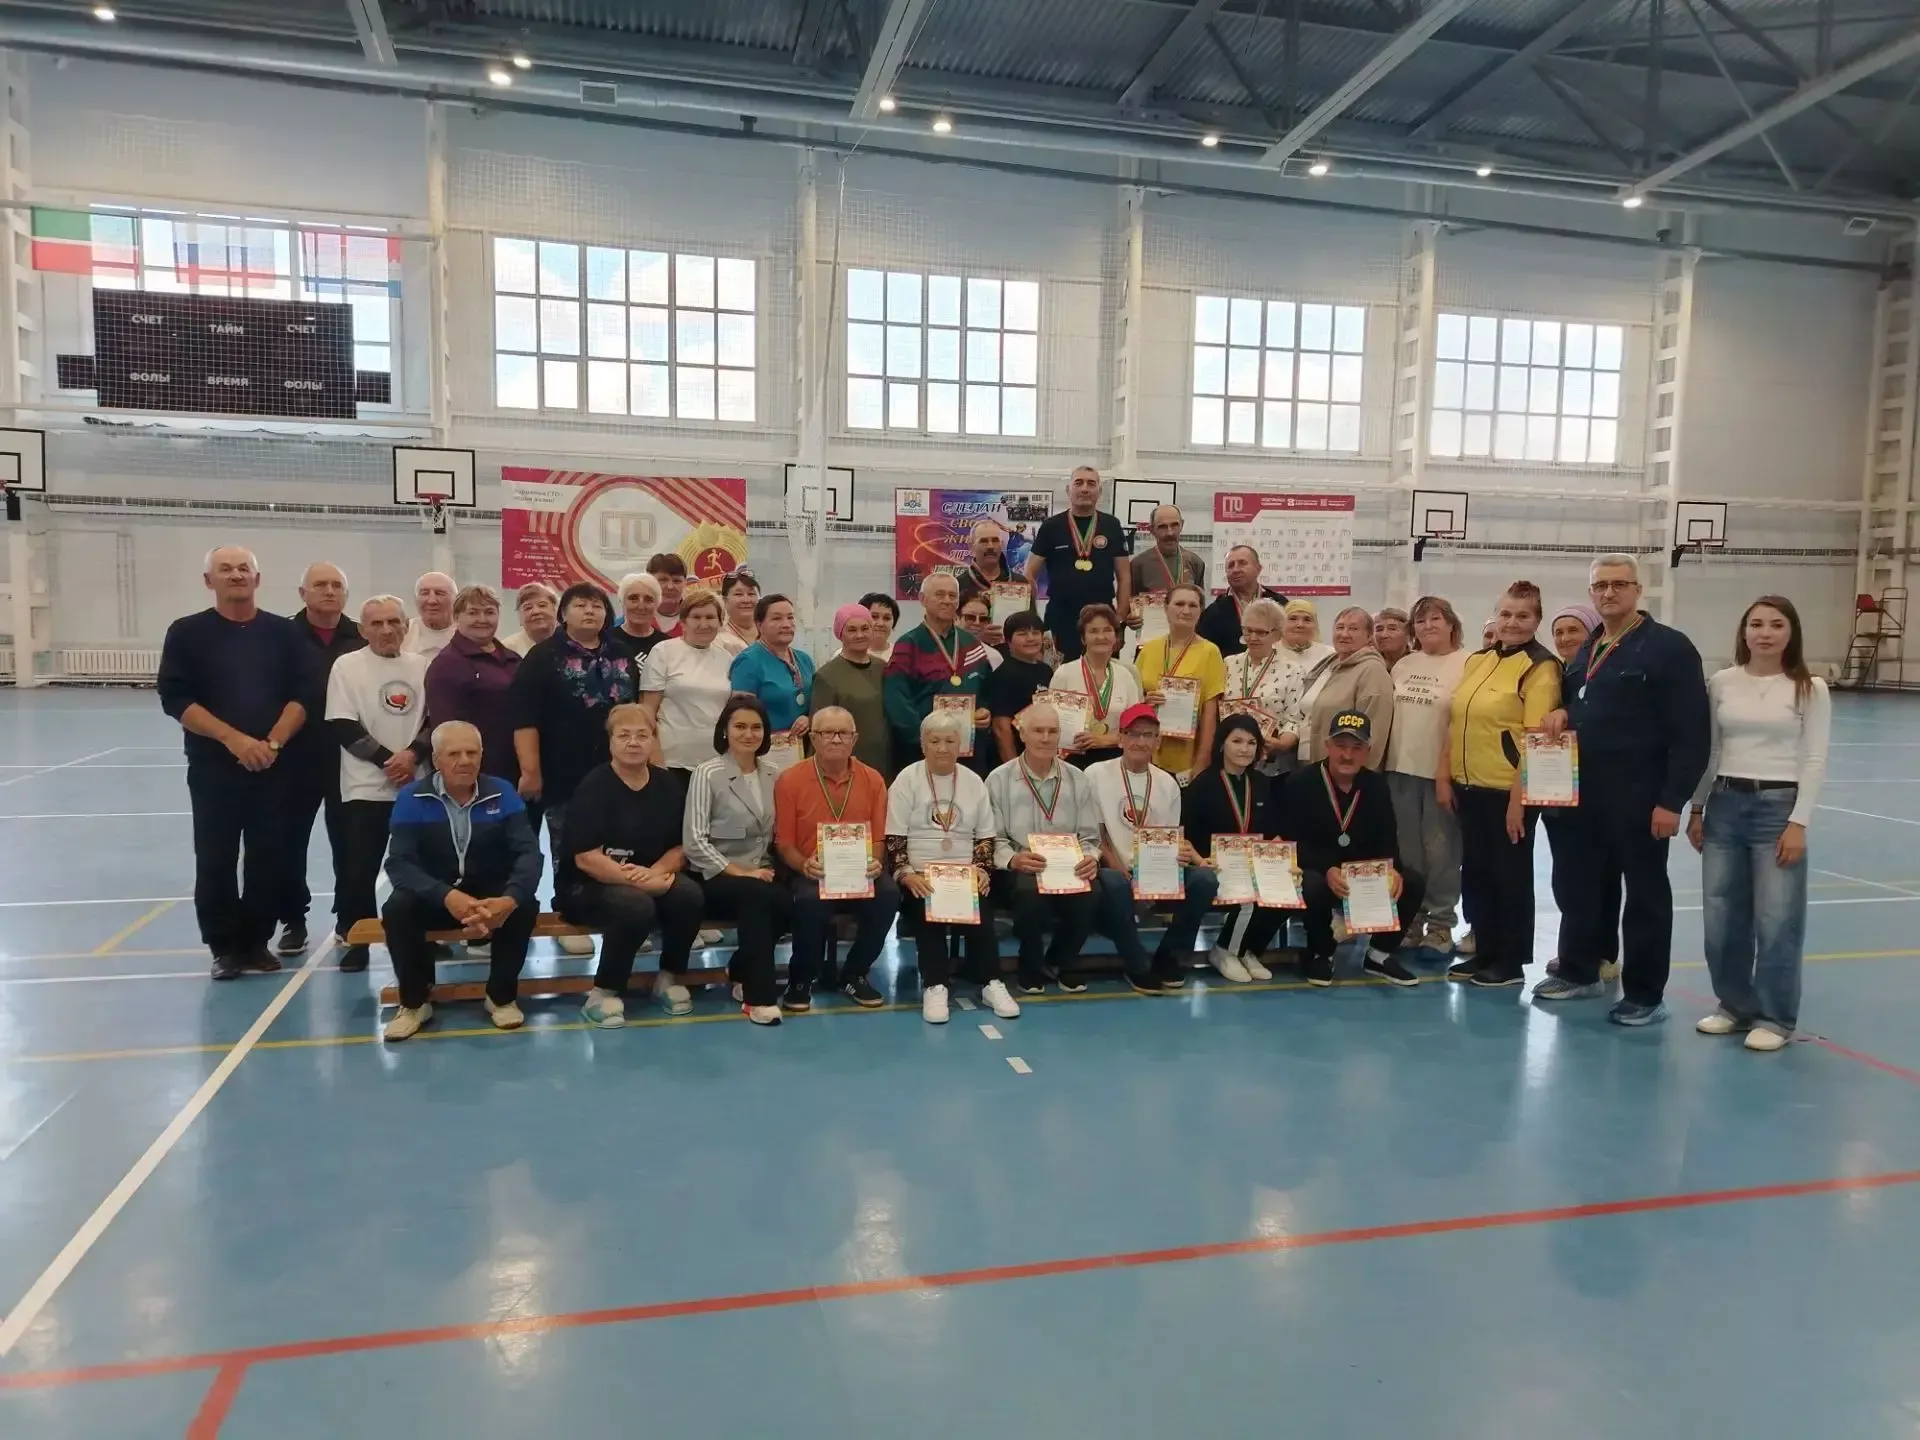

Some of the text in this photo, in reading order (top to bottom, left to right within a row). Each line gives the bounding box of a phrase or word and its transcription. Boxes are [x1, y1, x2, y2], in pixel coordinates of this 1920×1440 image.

[131, 314, 165, 325] СЧЕТ
[208, 322, 244, 335] ТАЙМ
[286, 323, 317, 334] СЧЕТ
[129, 371, 171, 383] ФОЛЫ
[207, 375, 249, 387] ВРЕМЯ
[284, 379, 322, 391] ФОЛЫ
[1222, 496, 1243, 512] ГТО
[950, 518, 977, 528] СВО
[599, 511, 657, 549] ГТО
[1338, 714, 1364, 728] СССР
